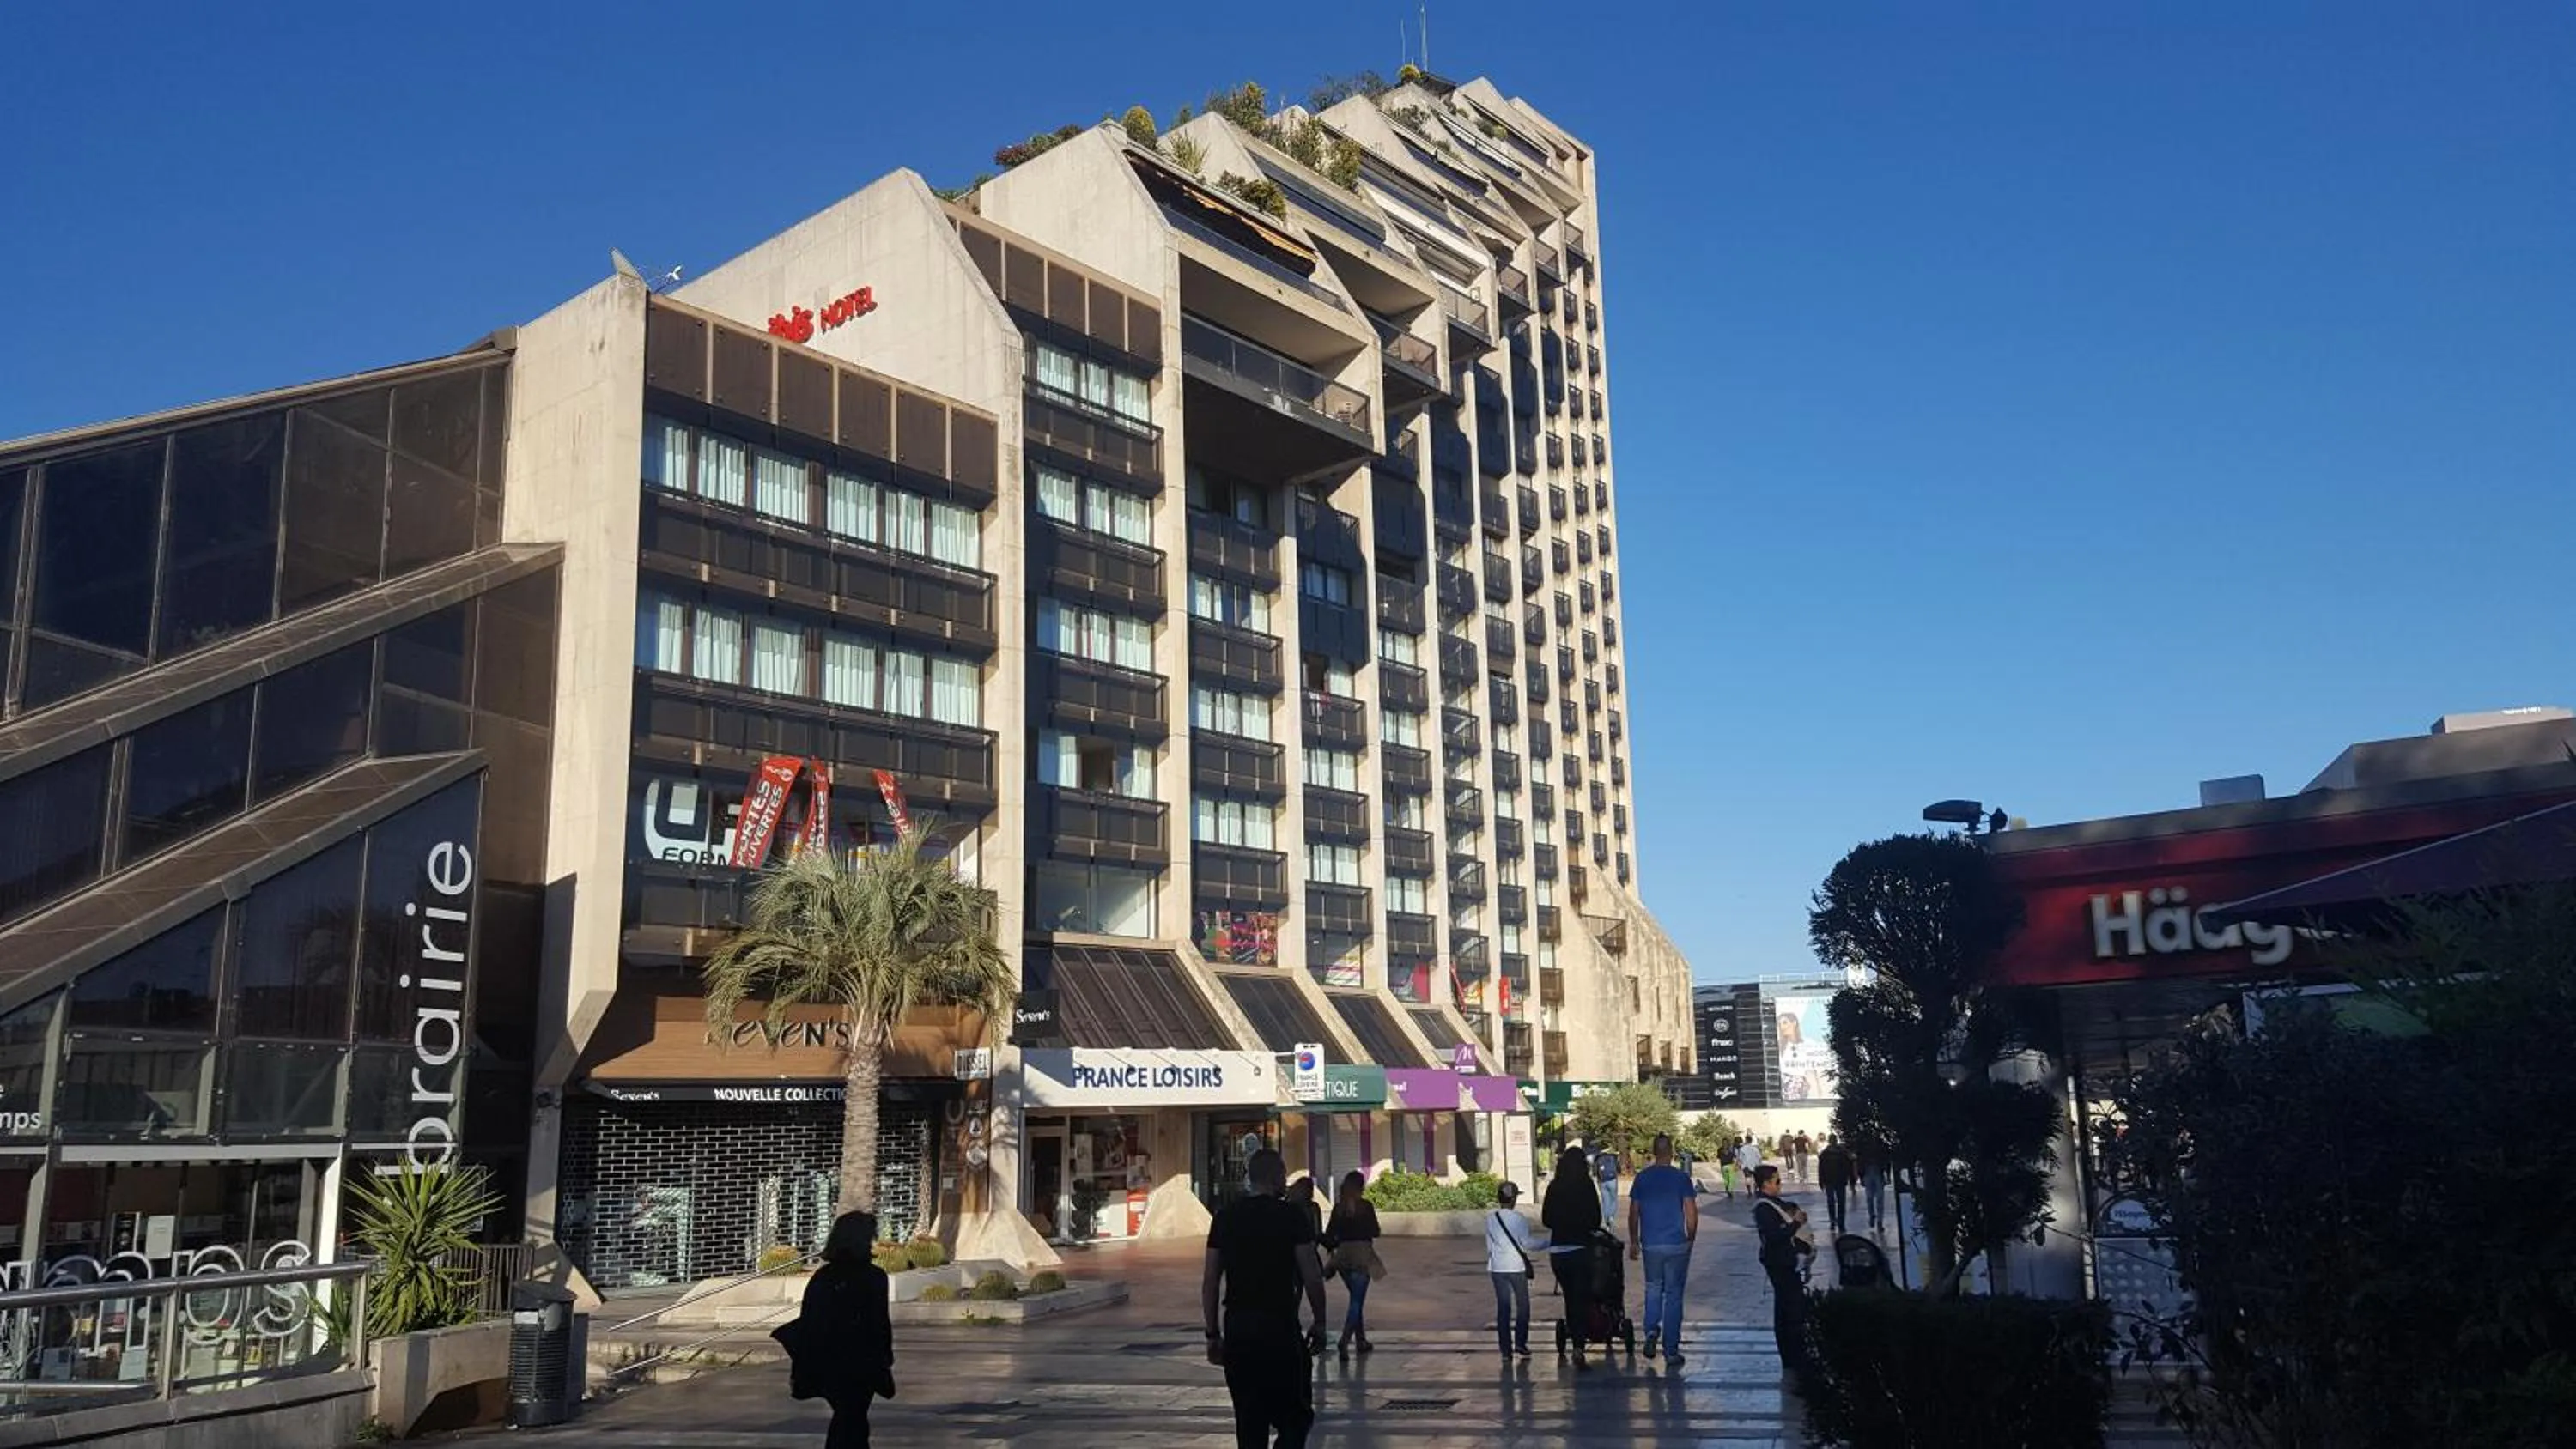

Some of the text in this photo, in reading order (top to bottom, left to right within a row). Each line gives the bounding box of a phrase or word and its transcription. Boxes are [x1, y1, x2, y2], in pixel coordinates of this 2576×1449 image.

[820, 286, 878, 335] HOTEL
[736, 779, 770, 866] PORTES
[746, 784, 783, 866] UVERTES
[957, 1053, 988, 1071] DIESEL
[1072, 1066, 1223, 1088] FRANCE LOISIRS
[714, 1088, 780, 1101] NOUVELLE
